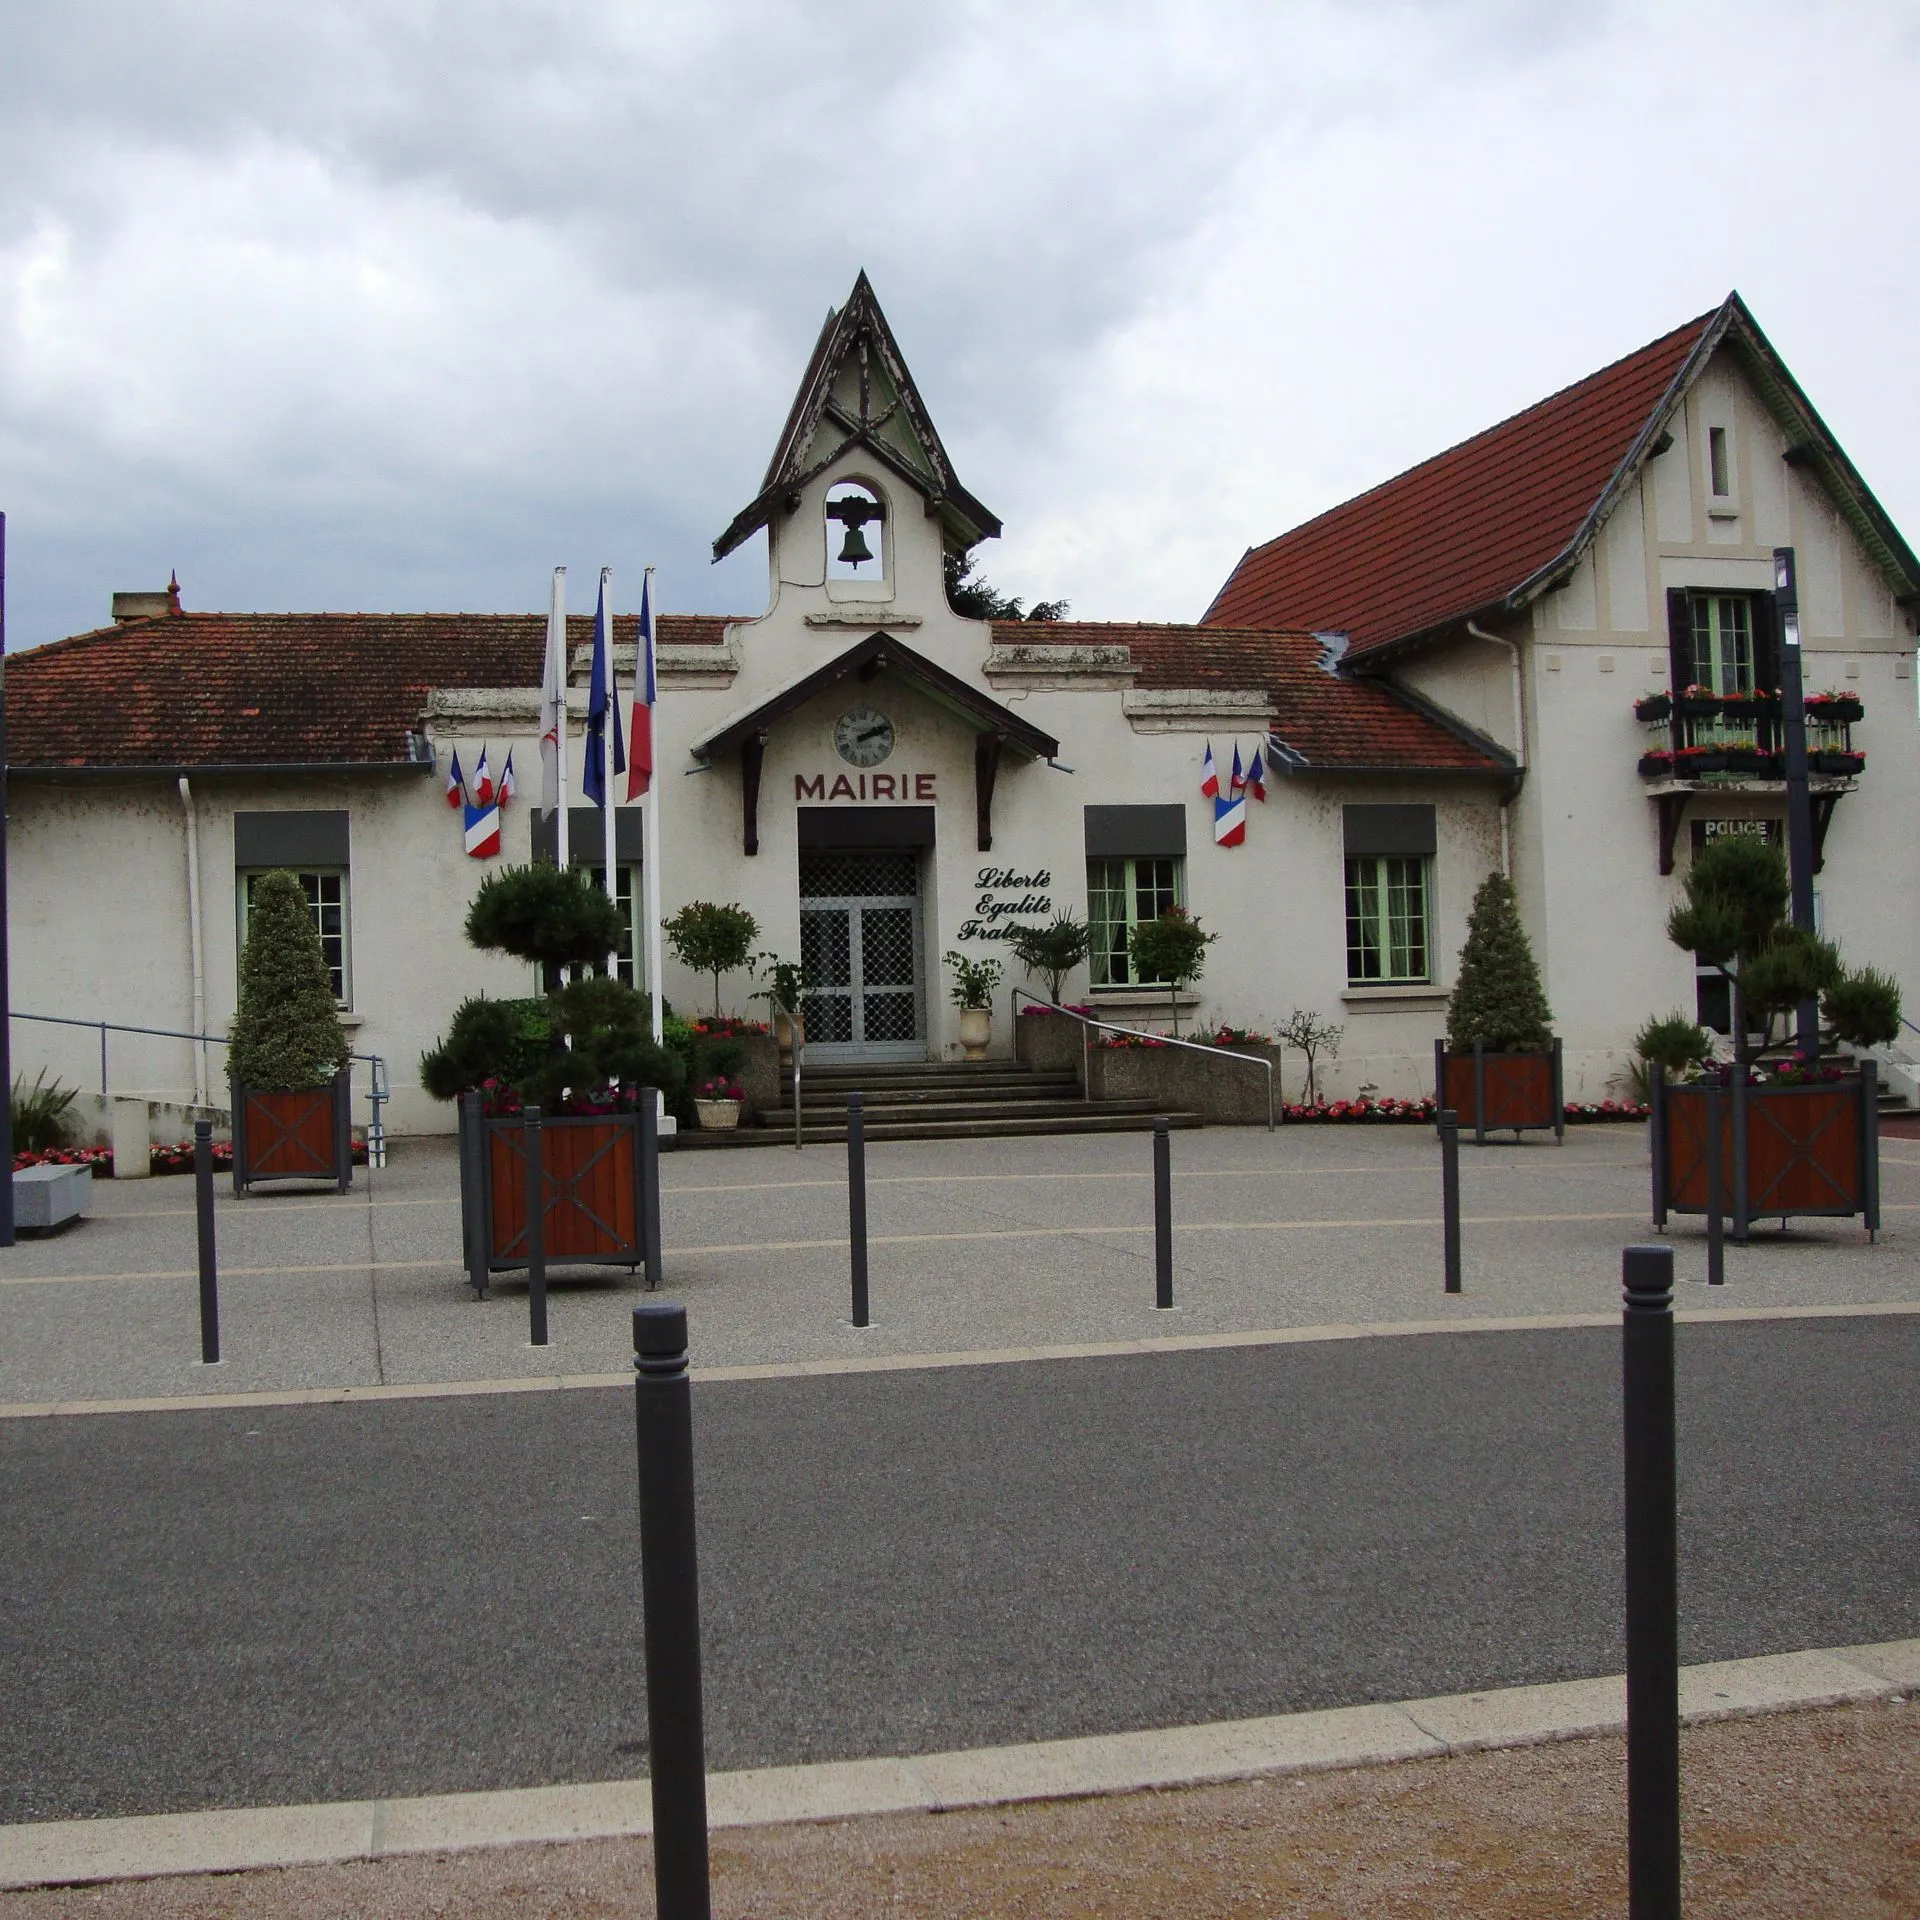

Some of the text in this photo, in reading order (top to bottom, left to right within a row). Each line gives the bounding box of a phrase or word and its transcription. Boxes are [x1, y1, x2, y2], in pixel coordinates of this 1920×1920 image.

[795, 774, 937, 800] MAIRIE
[1705, 821, 1768, 835] POLICE
[974, 867, 1051, 889] Liberté
[975, 893, 1051, 923] Egalité
